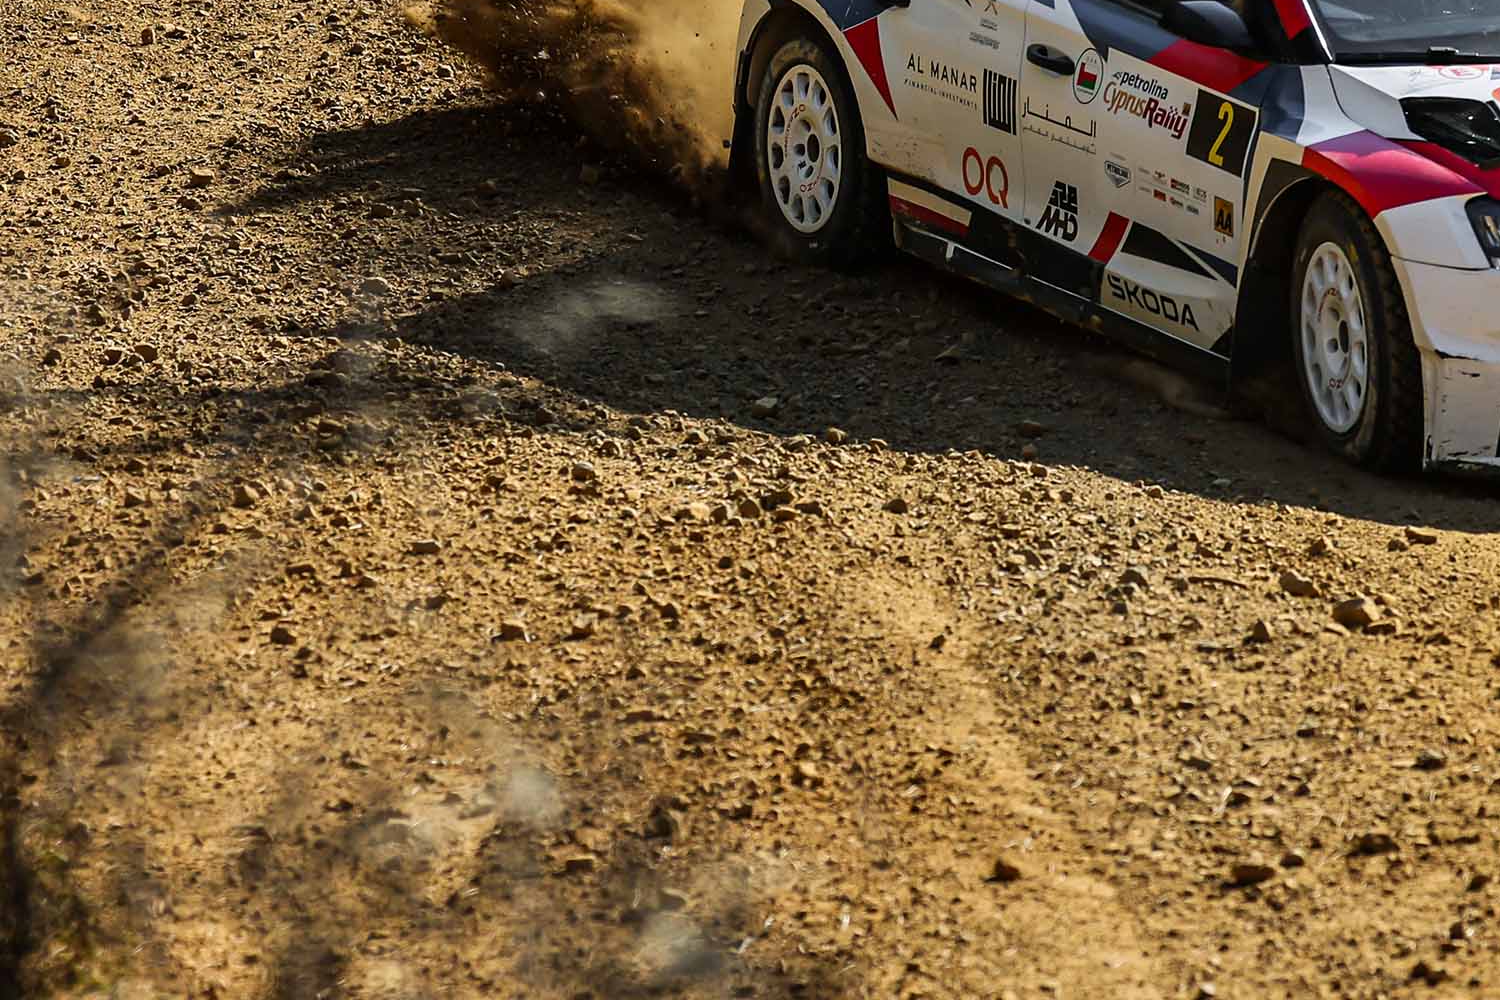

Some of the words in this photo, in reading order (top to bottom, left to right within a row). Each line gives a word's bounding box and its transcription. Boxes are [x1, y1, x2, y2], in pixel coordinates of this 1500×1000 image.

[906, 53, 924, 74] AL
[930, 60, 978, 94] MANAR
[1119, 71, 1169, 100] petrolina
[1207, 101, 1235, 167] 2
[962, 146, 1009, 210] OQ
